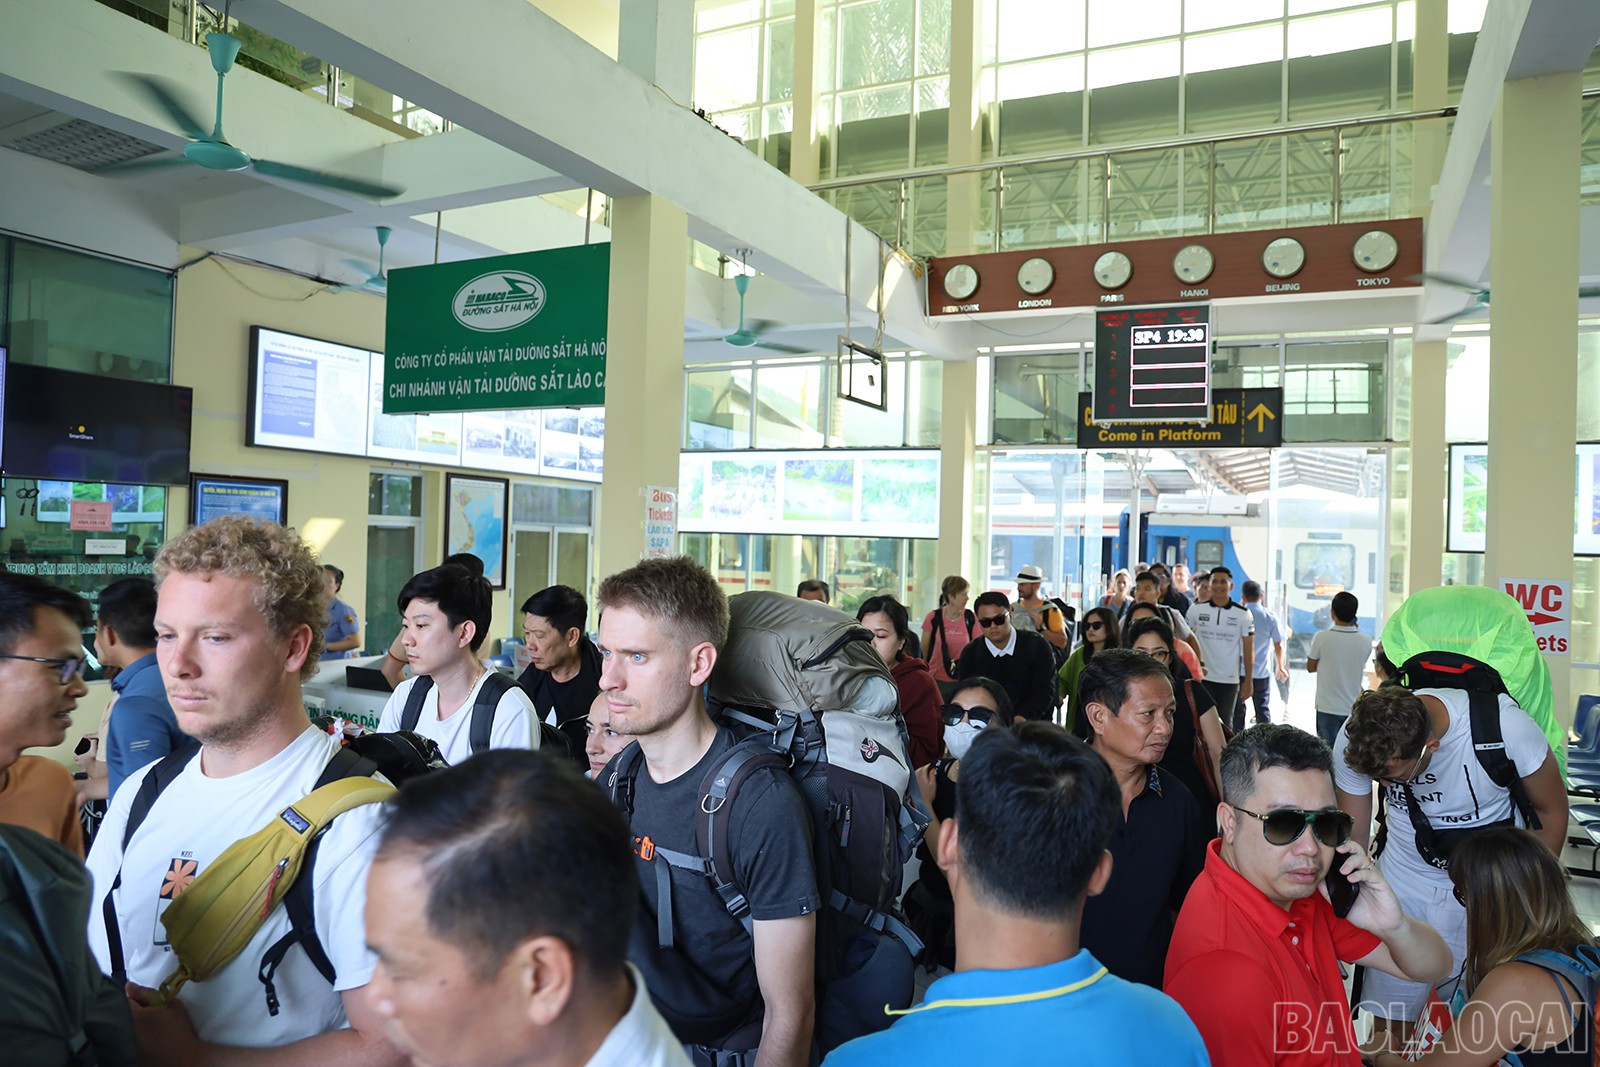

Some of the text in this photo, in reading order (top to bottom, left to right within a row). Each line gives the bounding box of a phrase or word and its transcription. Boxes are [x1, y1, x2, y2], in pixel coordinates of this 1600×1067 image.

[1265, 283, 1300, 292] BEIJING
[1357, 277, 1390, 286] TOKYO
[1100, 294, 1124, 302] PARIS
[1180, 289, 1209, 297] HANOI
[1018, 299, 1052, 308] LONDON
[1134, 328, 1204, 344] SP4 19:30
[394, 352, 419, 369] CÔNG
[421, 354, 432, 367] TY
[434, 345, 447, 367] CỔ
[476, 346, 496, 368] VẬN
[498, 342, 513, 362] TẢI
[515, 342, 550, 361] ĐƯỜNG
[552, 335, 572, 359] SẮT
[574, 339, 588, 357] HÀ
[591, 337, 607, 360] NỘ
[1110, 350, 1117, 360] 2
[389, 383, 406, 398] CHI
[408, 377, 446, 397] NHÁNH
[448, 376, 472, 400] VẬN
[474, 371, 492, 394] TẢI
[495, 371, 537, 393] ĐƯỜNG
[540, 363, 564, 391] SẮT
[567, 368, 591, 389] LÀO
[1216, 399, 1237, 425] TÀU
[1098, 428, 1221, 442] Come in Platform
[1505, 583, 1563, 612] WC
